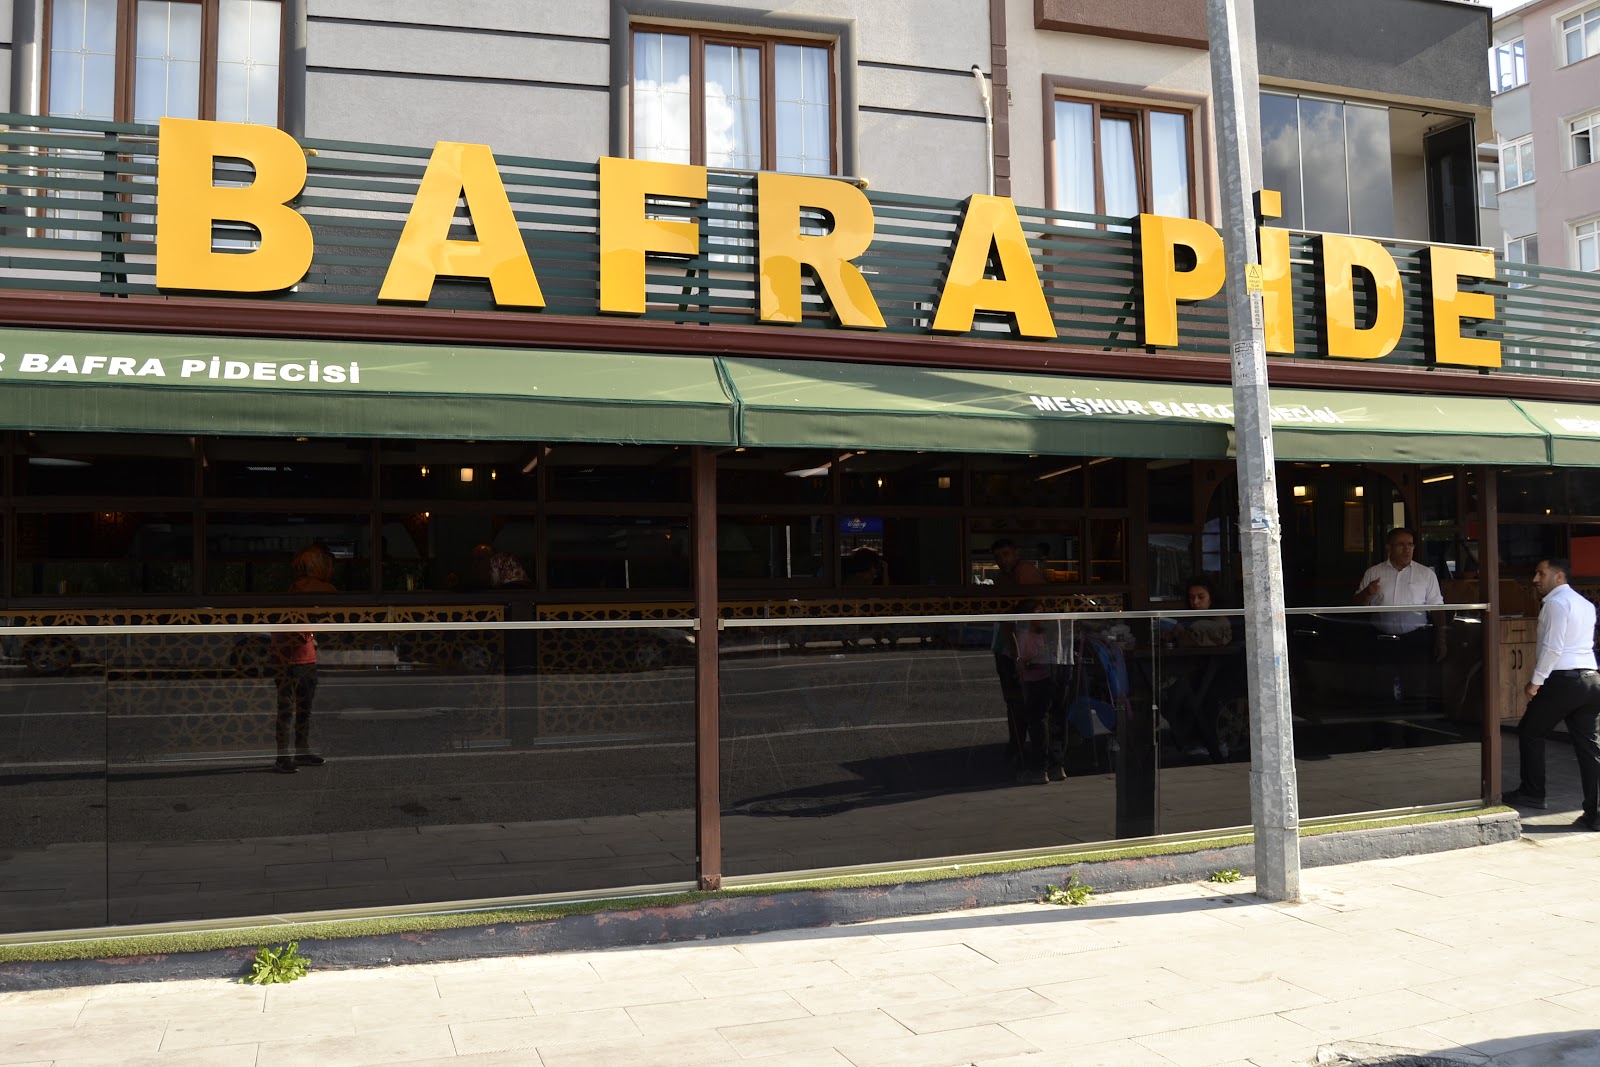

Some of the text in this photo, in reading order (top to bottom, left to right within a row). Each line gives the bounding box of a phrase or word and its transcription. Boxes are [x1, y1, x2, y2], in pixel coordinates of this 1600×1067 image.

[156, 116, 1502, 368] BAFRA PİDE
[19, 353, 166, 377] BAFRA
[180, 355, 361, 384] PİDECİSİ
[1029, 395, 1150, 416] MEŞHUR
[1148, 400, 1235, 419] BAFRA
